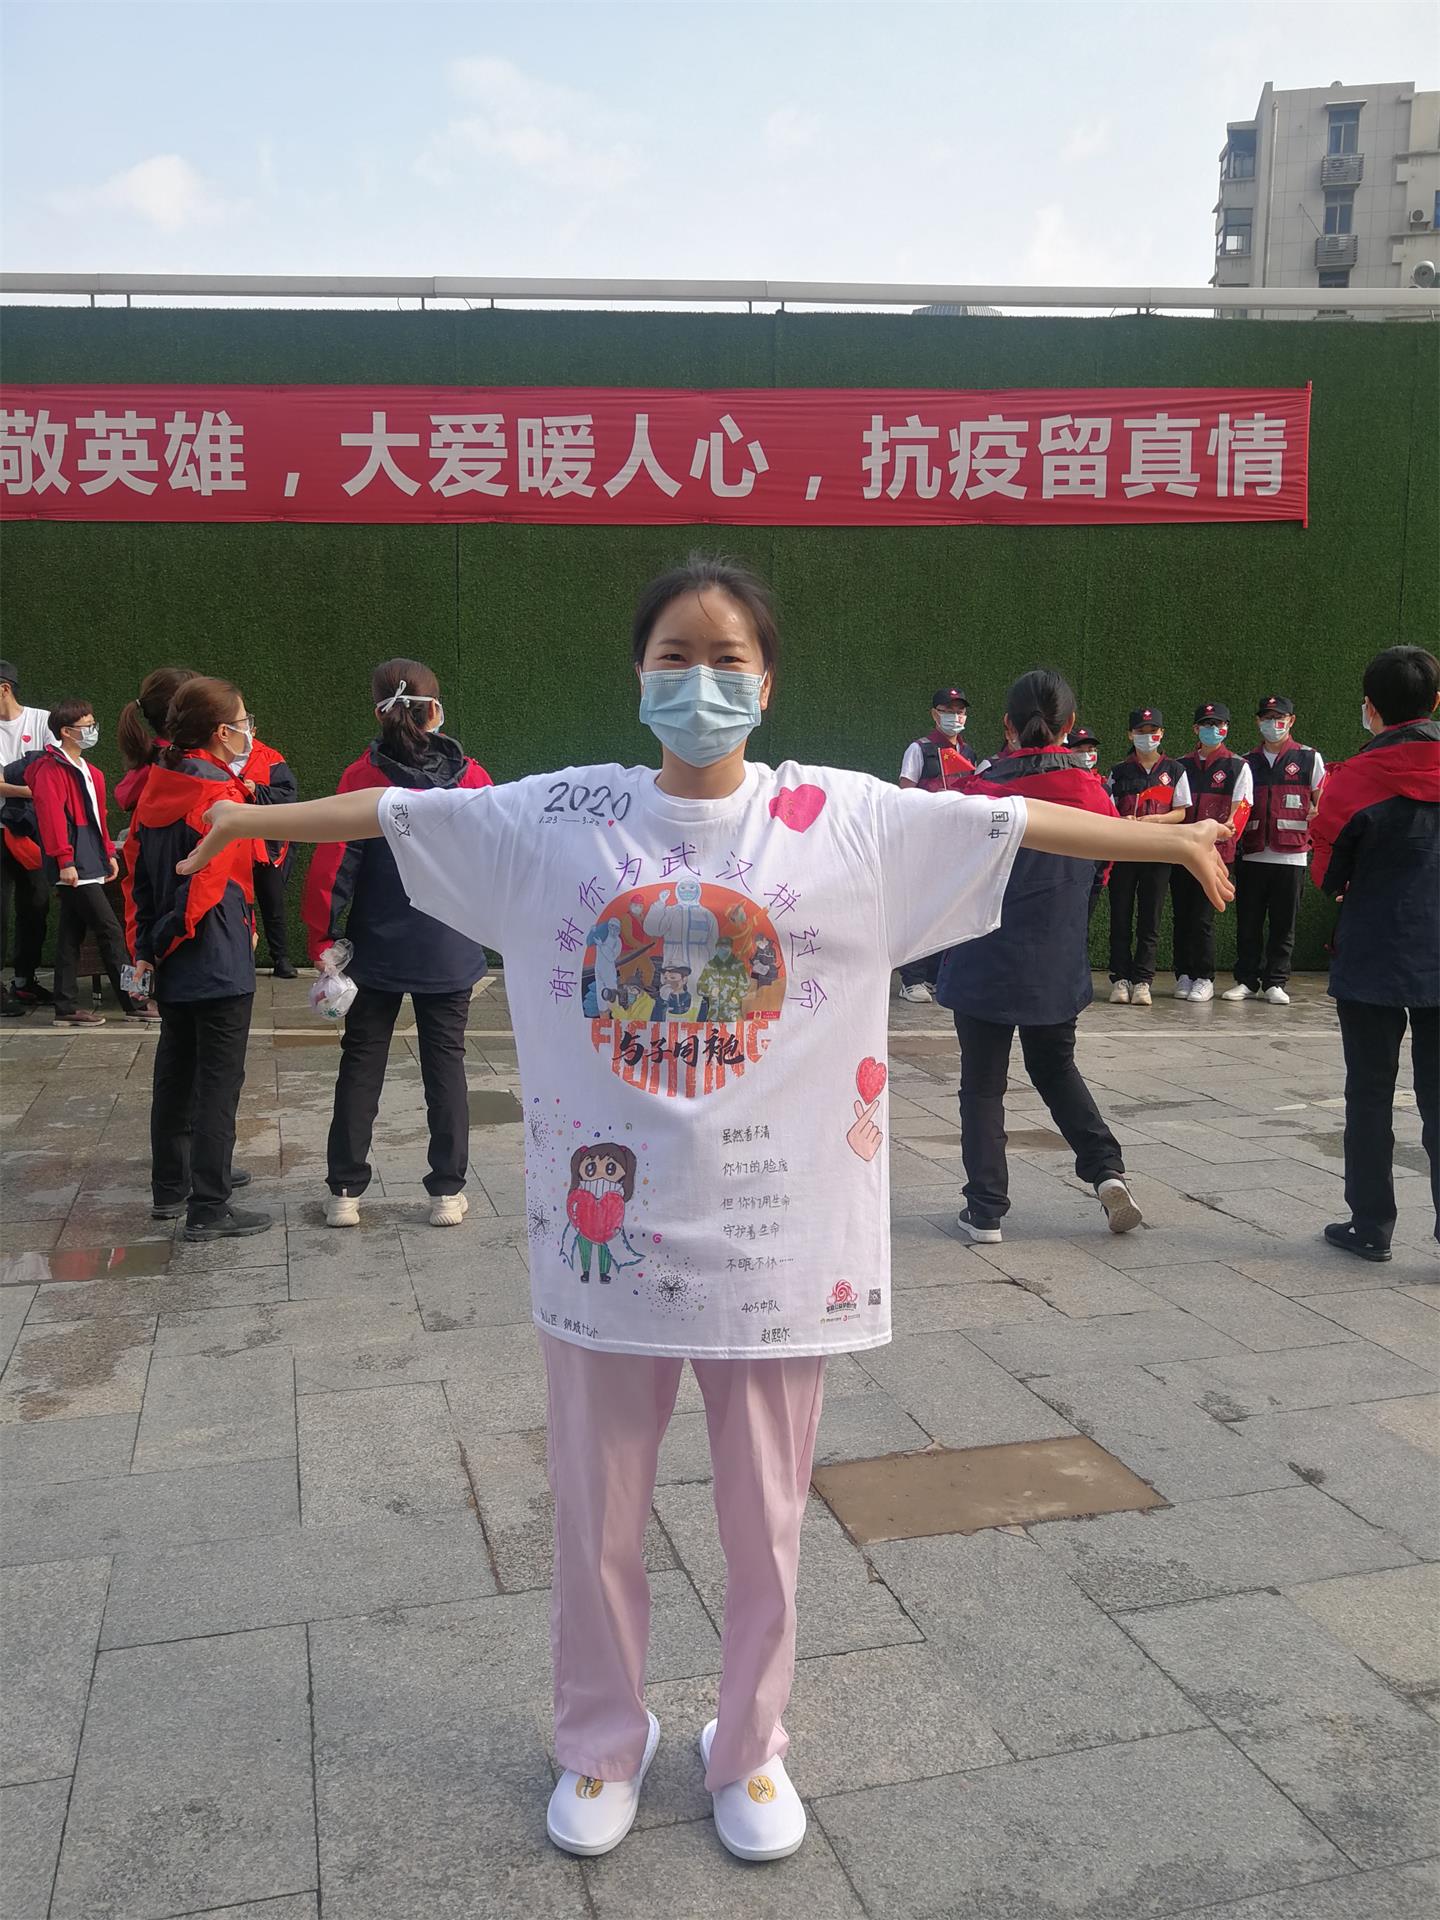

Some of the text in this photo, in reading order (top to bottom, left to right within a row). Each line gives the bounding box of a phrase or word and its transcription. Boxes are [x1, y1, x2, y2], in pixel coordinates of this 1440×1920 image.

[544, 781, 632, 821] 2020
[987, 811, 1010, 839] 中国
[547, 842, 828, 1016] 谢谢你为武汉拼过命
[590, 1019, 773, 1098] FIGHTING
[612, 1029, 746, 1068] 与子同袍
[720, 1124, 771, 1146] 虽然看不清
[721, 1221, 781, 1240] 守护着生命
